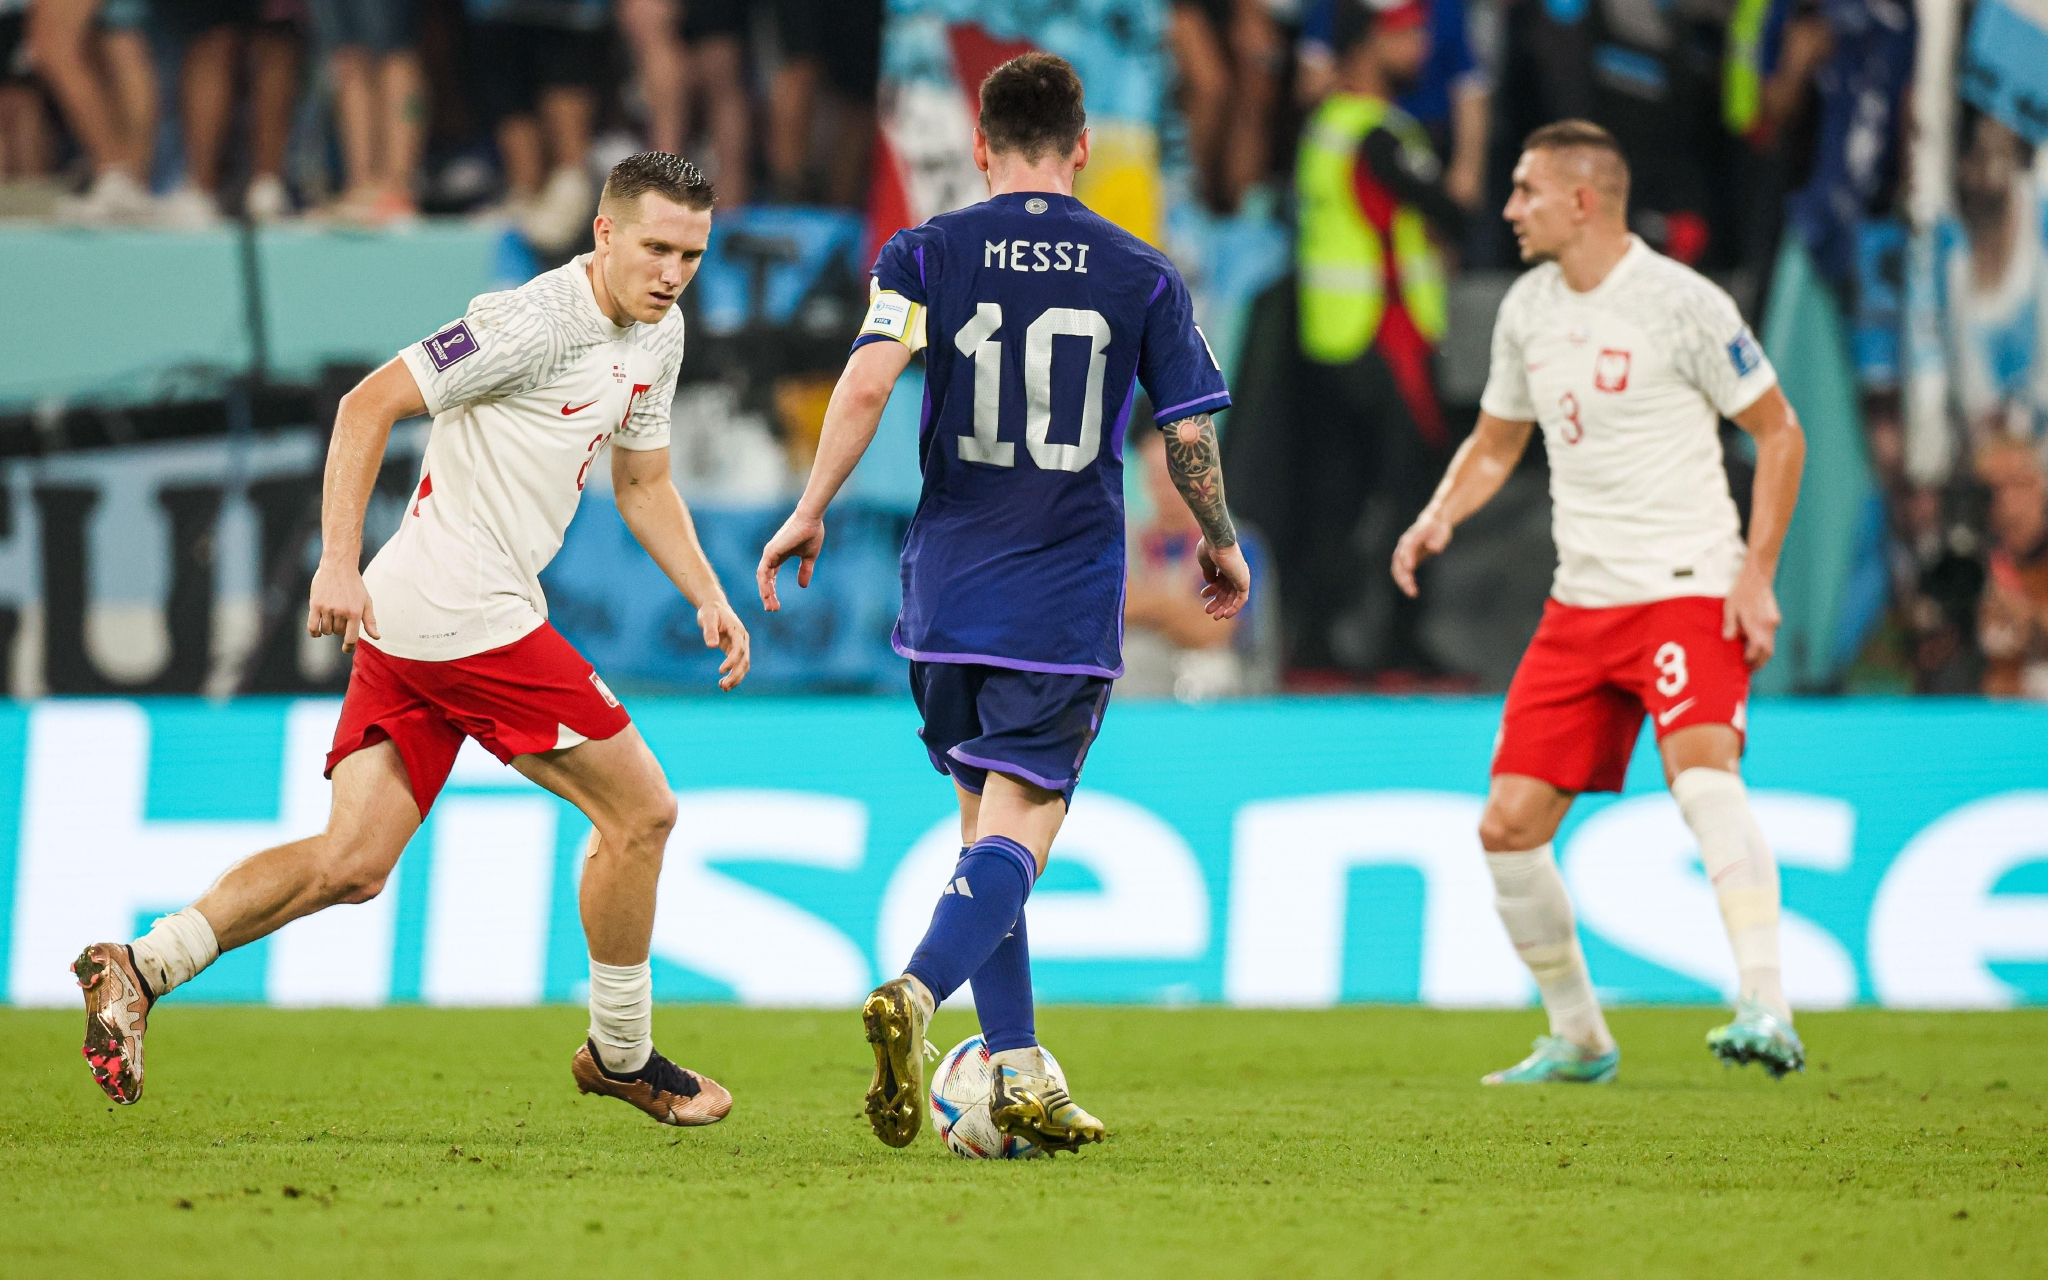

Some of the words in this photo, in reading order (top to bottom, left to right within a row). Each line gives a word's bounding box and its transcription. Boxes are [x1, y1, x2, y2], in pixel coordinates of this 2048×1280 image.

[984, 239, 1090, 274] MESSI
[875, 317, 890, 325] FIFA
[954, 302, 1112, 473] 10
[1558, 390, 1584, 445] 3
[1653, 641, 1689, 698] 3
